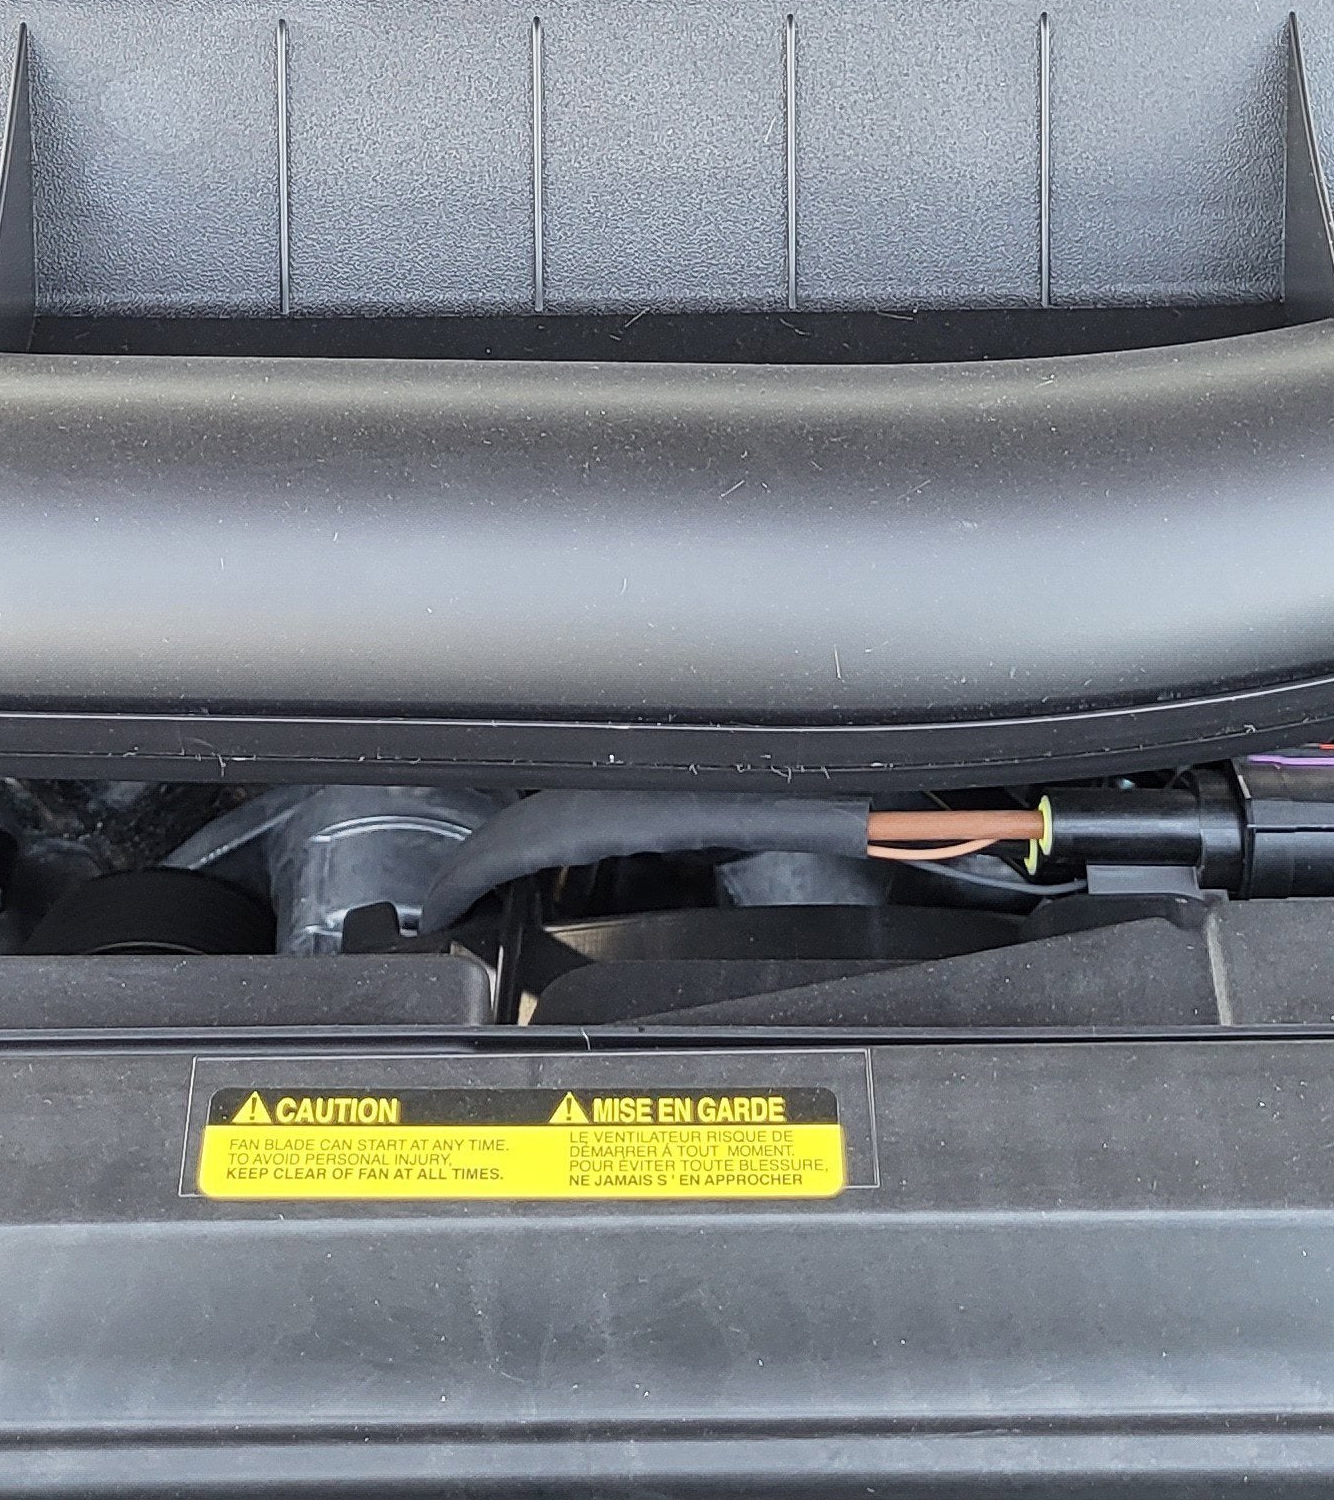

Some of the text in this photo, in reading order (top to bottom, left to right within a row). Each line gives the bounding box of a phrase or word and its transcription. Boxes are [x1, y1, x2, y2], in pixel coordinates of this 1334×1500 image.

[275, 1097, 399, 1124] CAUTION
[593, 1097, 786, 1122] MISE EN GARDE
[570, 1130, 794, 1143] LE VENTILATEUR RISQUE DE
[229, 1138, 260, 1151] FAN
[264, 1138, 314, 1151] BLADE
[319, 1138, 354, 1151] CAN
[357, 1138, 405, 1151] START
[410, 1138, 429, 1151] AT
[432, 1138, 463, 1151] ANY
[677, 1145, 717, 1157] TOUT
[728, 1145, 794, 1157] MOMENT.
[228, 1153, 452, 1167] TO AVOID PERSONAL INJURY,
[570, 1159, 613, 1172] POUR
[683, 1159, 733, 1171] TOUTE
[739, 1159, 829, 1173] BLESSURE,
[226, 1167, 504, 1180] KEEP CLEAR OF FAN AT ALL TIMES.
[569, 1174, 590, 1186] NE
[595, 1174, 653, 1186] JAMAIS
[704, 1174, 803, 1186] APPROCHER
